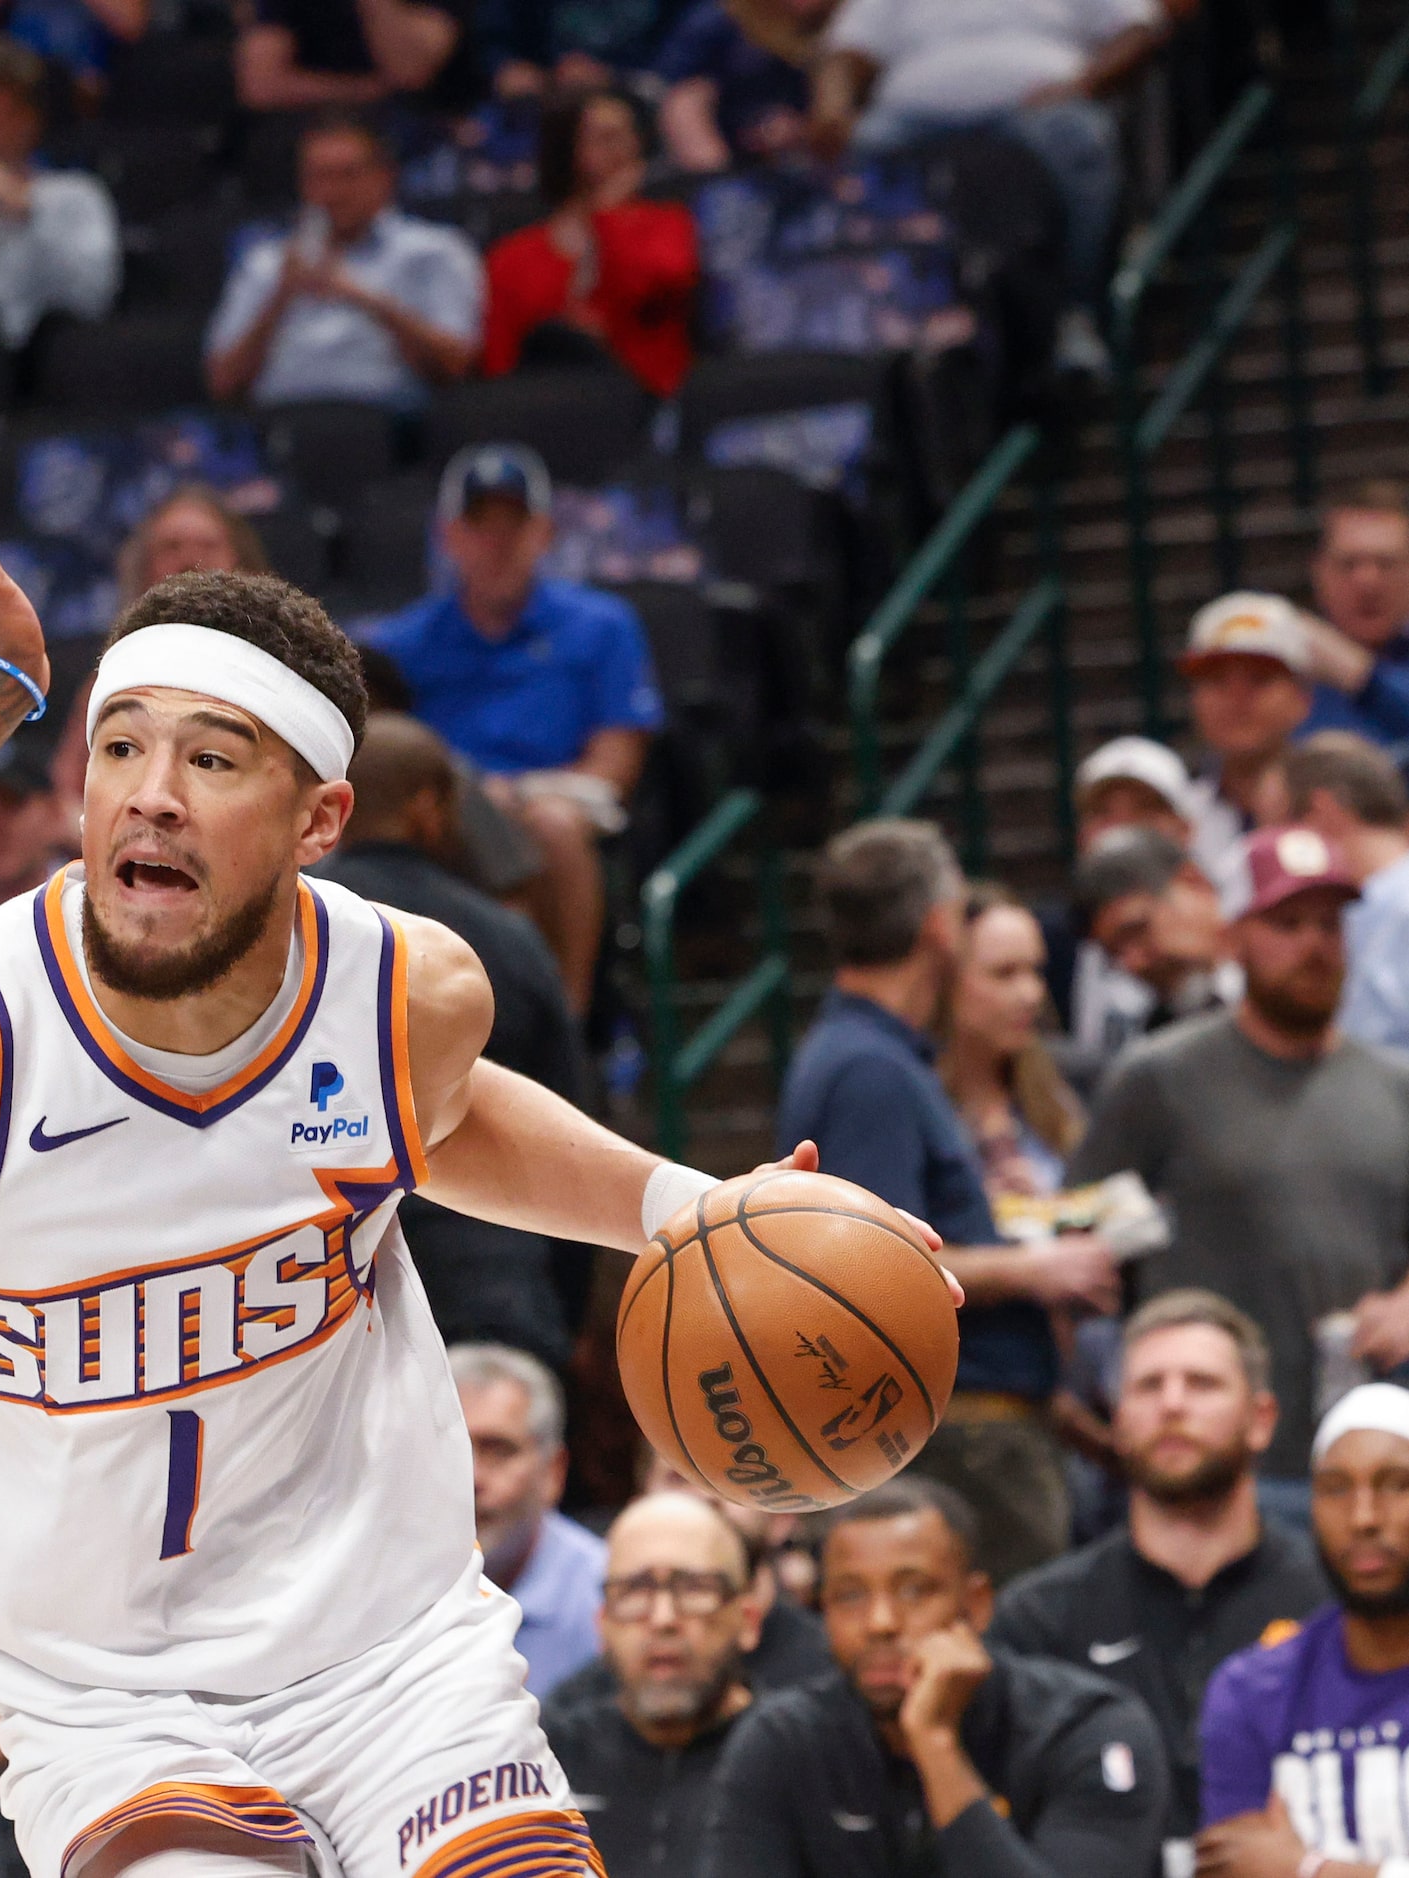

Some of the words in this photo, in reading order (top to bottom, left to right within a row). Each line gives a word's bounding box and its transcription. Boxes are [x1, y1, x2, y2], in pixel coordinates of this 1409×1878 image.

[291, 1115, 369, 1145] PayPal
[159, 1409, 205, 1561] 1
[397, 1761, 552, 1870] PHOENIX
